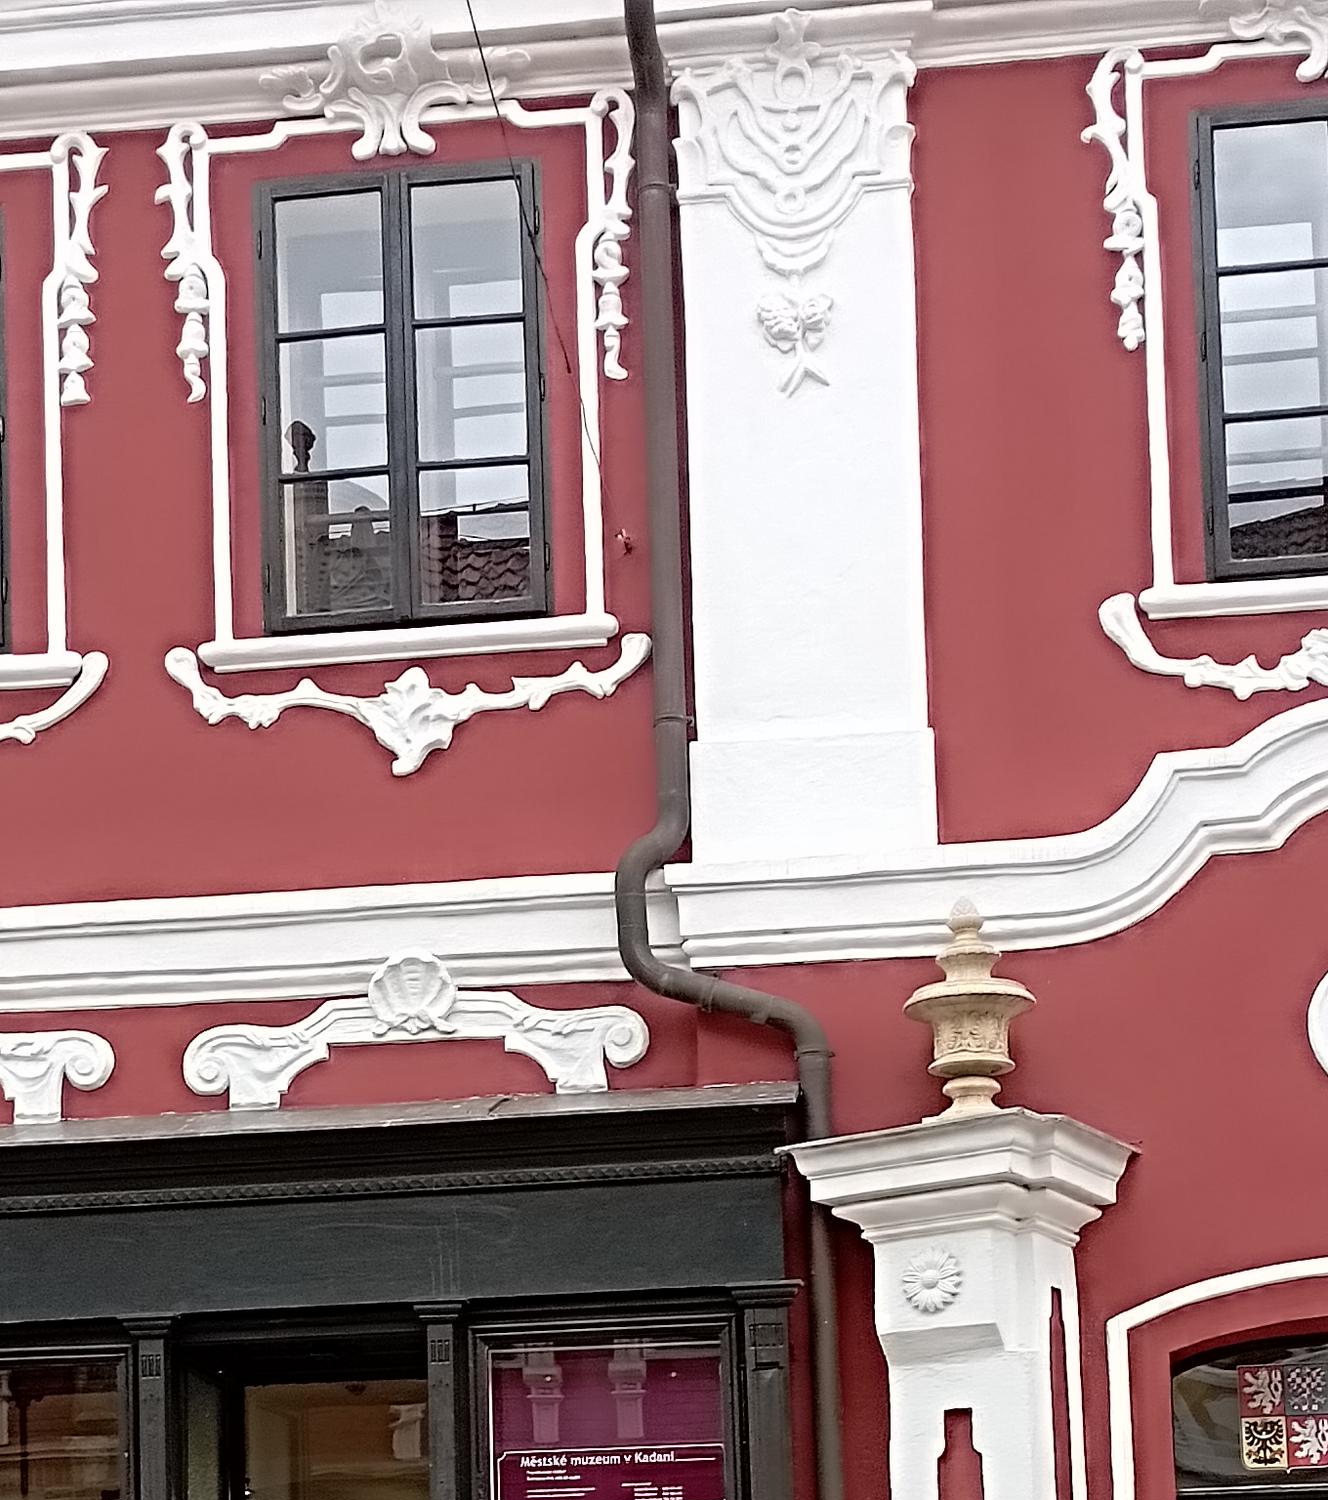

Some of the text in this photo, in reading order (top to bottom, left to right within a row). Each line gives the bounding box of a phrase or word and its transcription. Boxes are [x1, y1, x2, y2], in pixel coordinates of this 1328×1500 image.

[520, 1451, 674, 1467] Městské muzeum v Kadani
